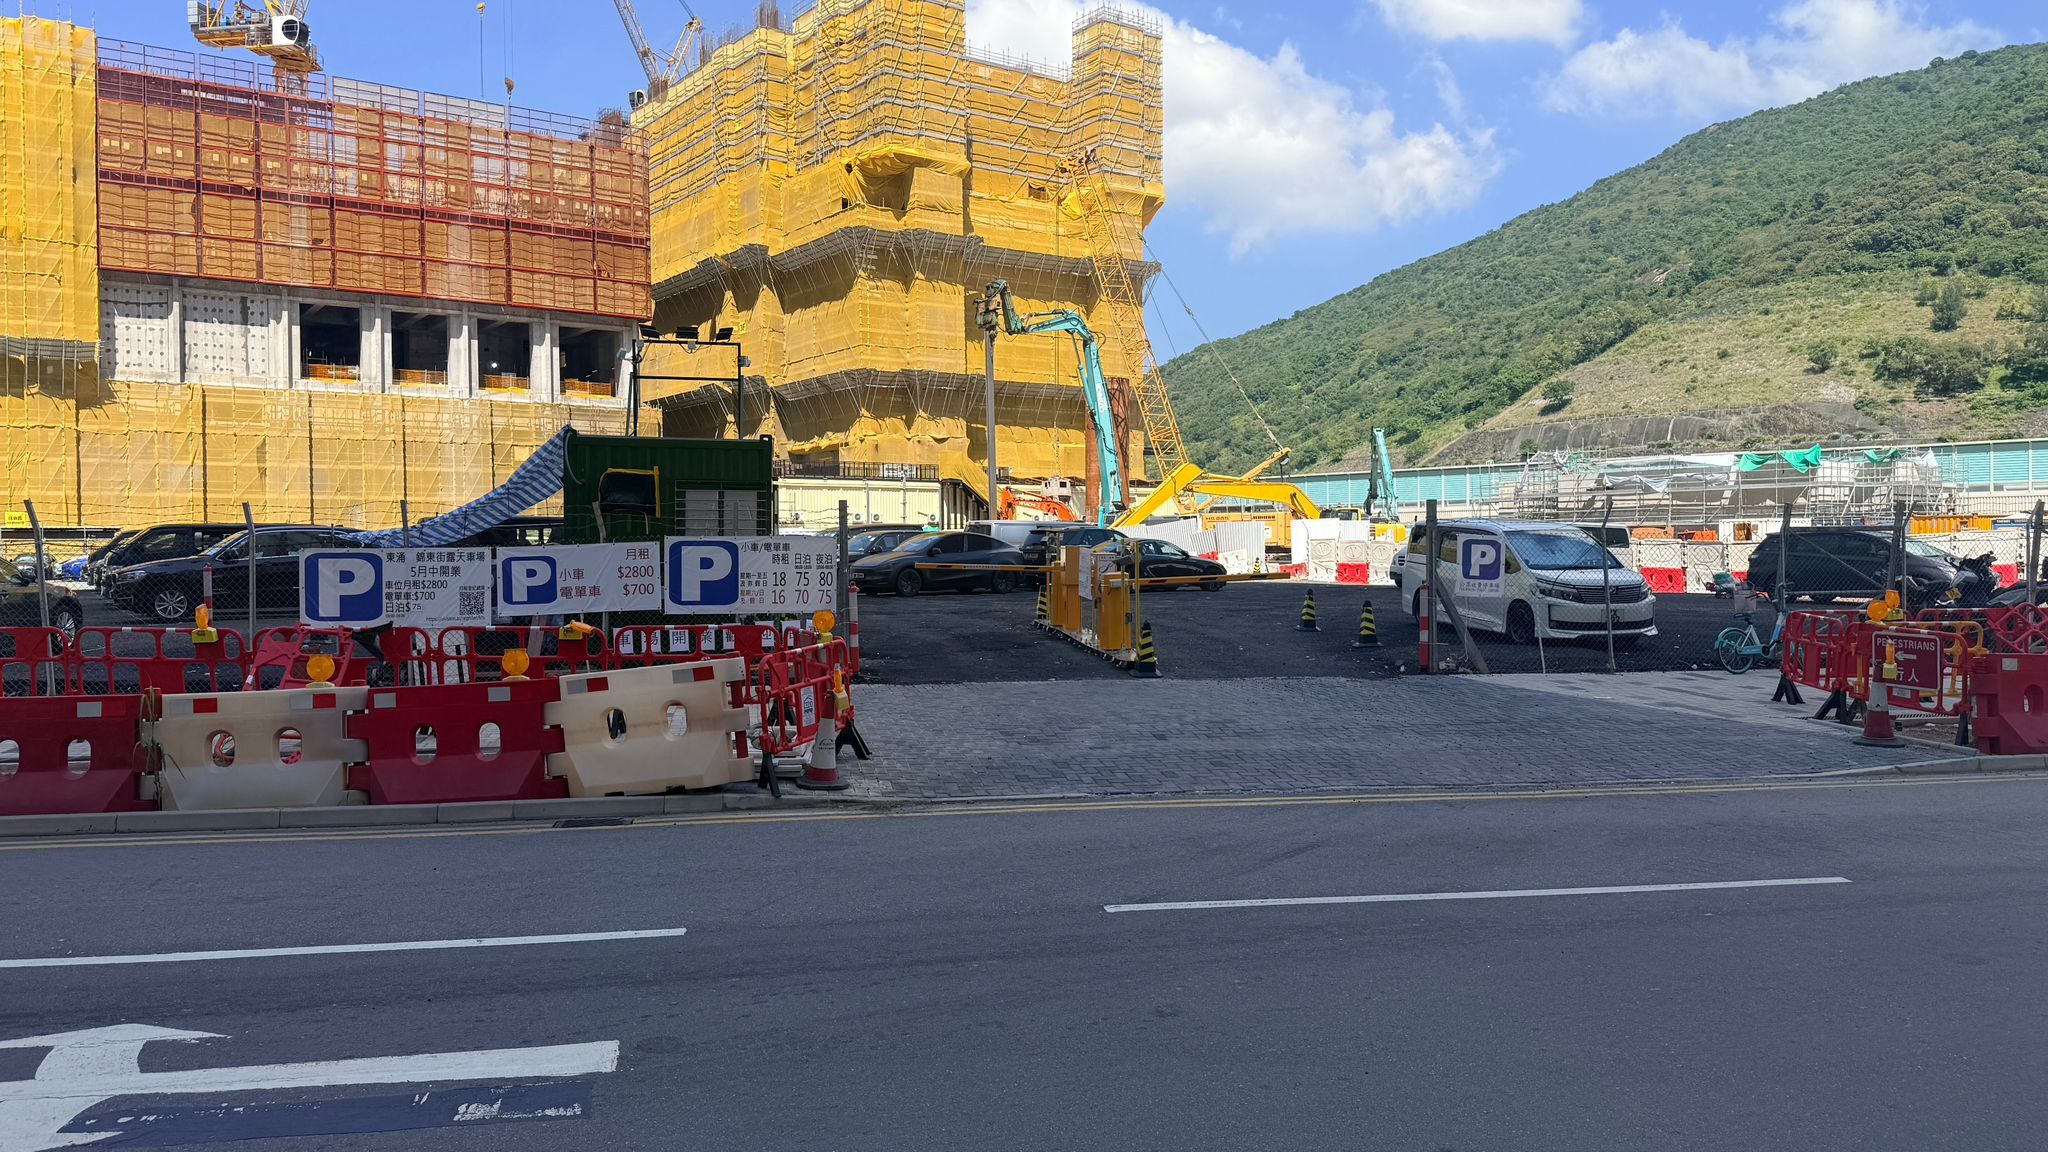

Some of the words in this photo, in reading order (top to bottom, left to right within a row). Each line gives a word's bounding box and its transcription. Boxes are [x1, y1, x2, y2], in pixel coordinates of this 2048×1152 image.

[626, 548, 650, 560] 月租
[741, 542, 791, 552] 小車/電單車
[386, 552, 406, 563] 東涌
[772, 553, 790, 565] 時租
[794, 553, 811, 565] 日泊
[816, 553, 833, 565] 夜泊
[1470, 545, 1496, 576] P
[411, 566, 461, 578] 5月中開業
[559, 568, 585, 581] 小車
[617, 565, 654, 579] $2800
[681, 545, 732, 602] P
[773, 571, 787, 587] 18
[796, 571, 810, 587] 75
[819, 571, 833, 587] 80
[318, 558, 376, 617] P
[385, 579, 448, 590] 車位月租$2800
[511, 560, 552, 603] P
[560, 585, 601, 599] 電單車
[623, 583, 655, 597] $700
[771, 589, 786, 605] 16
[795, 589, 809, 605] 70
[818, 589, 832, 605] 75
[1877, 637, 1936, 651] PEESTRIANS
